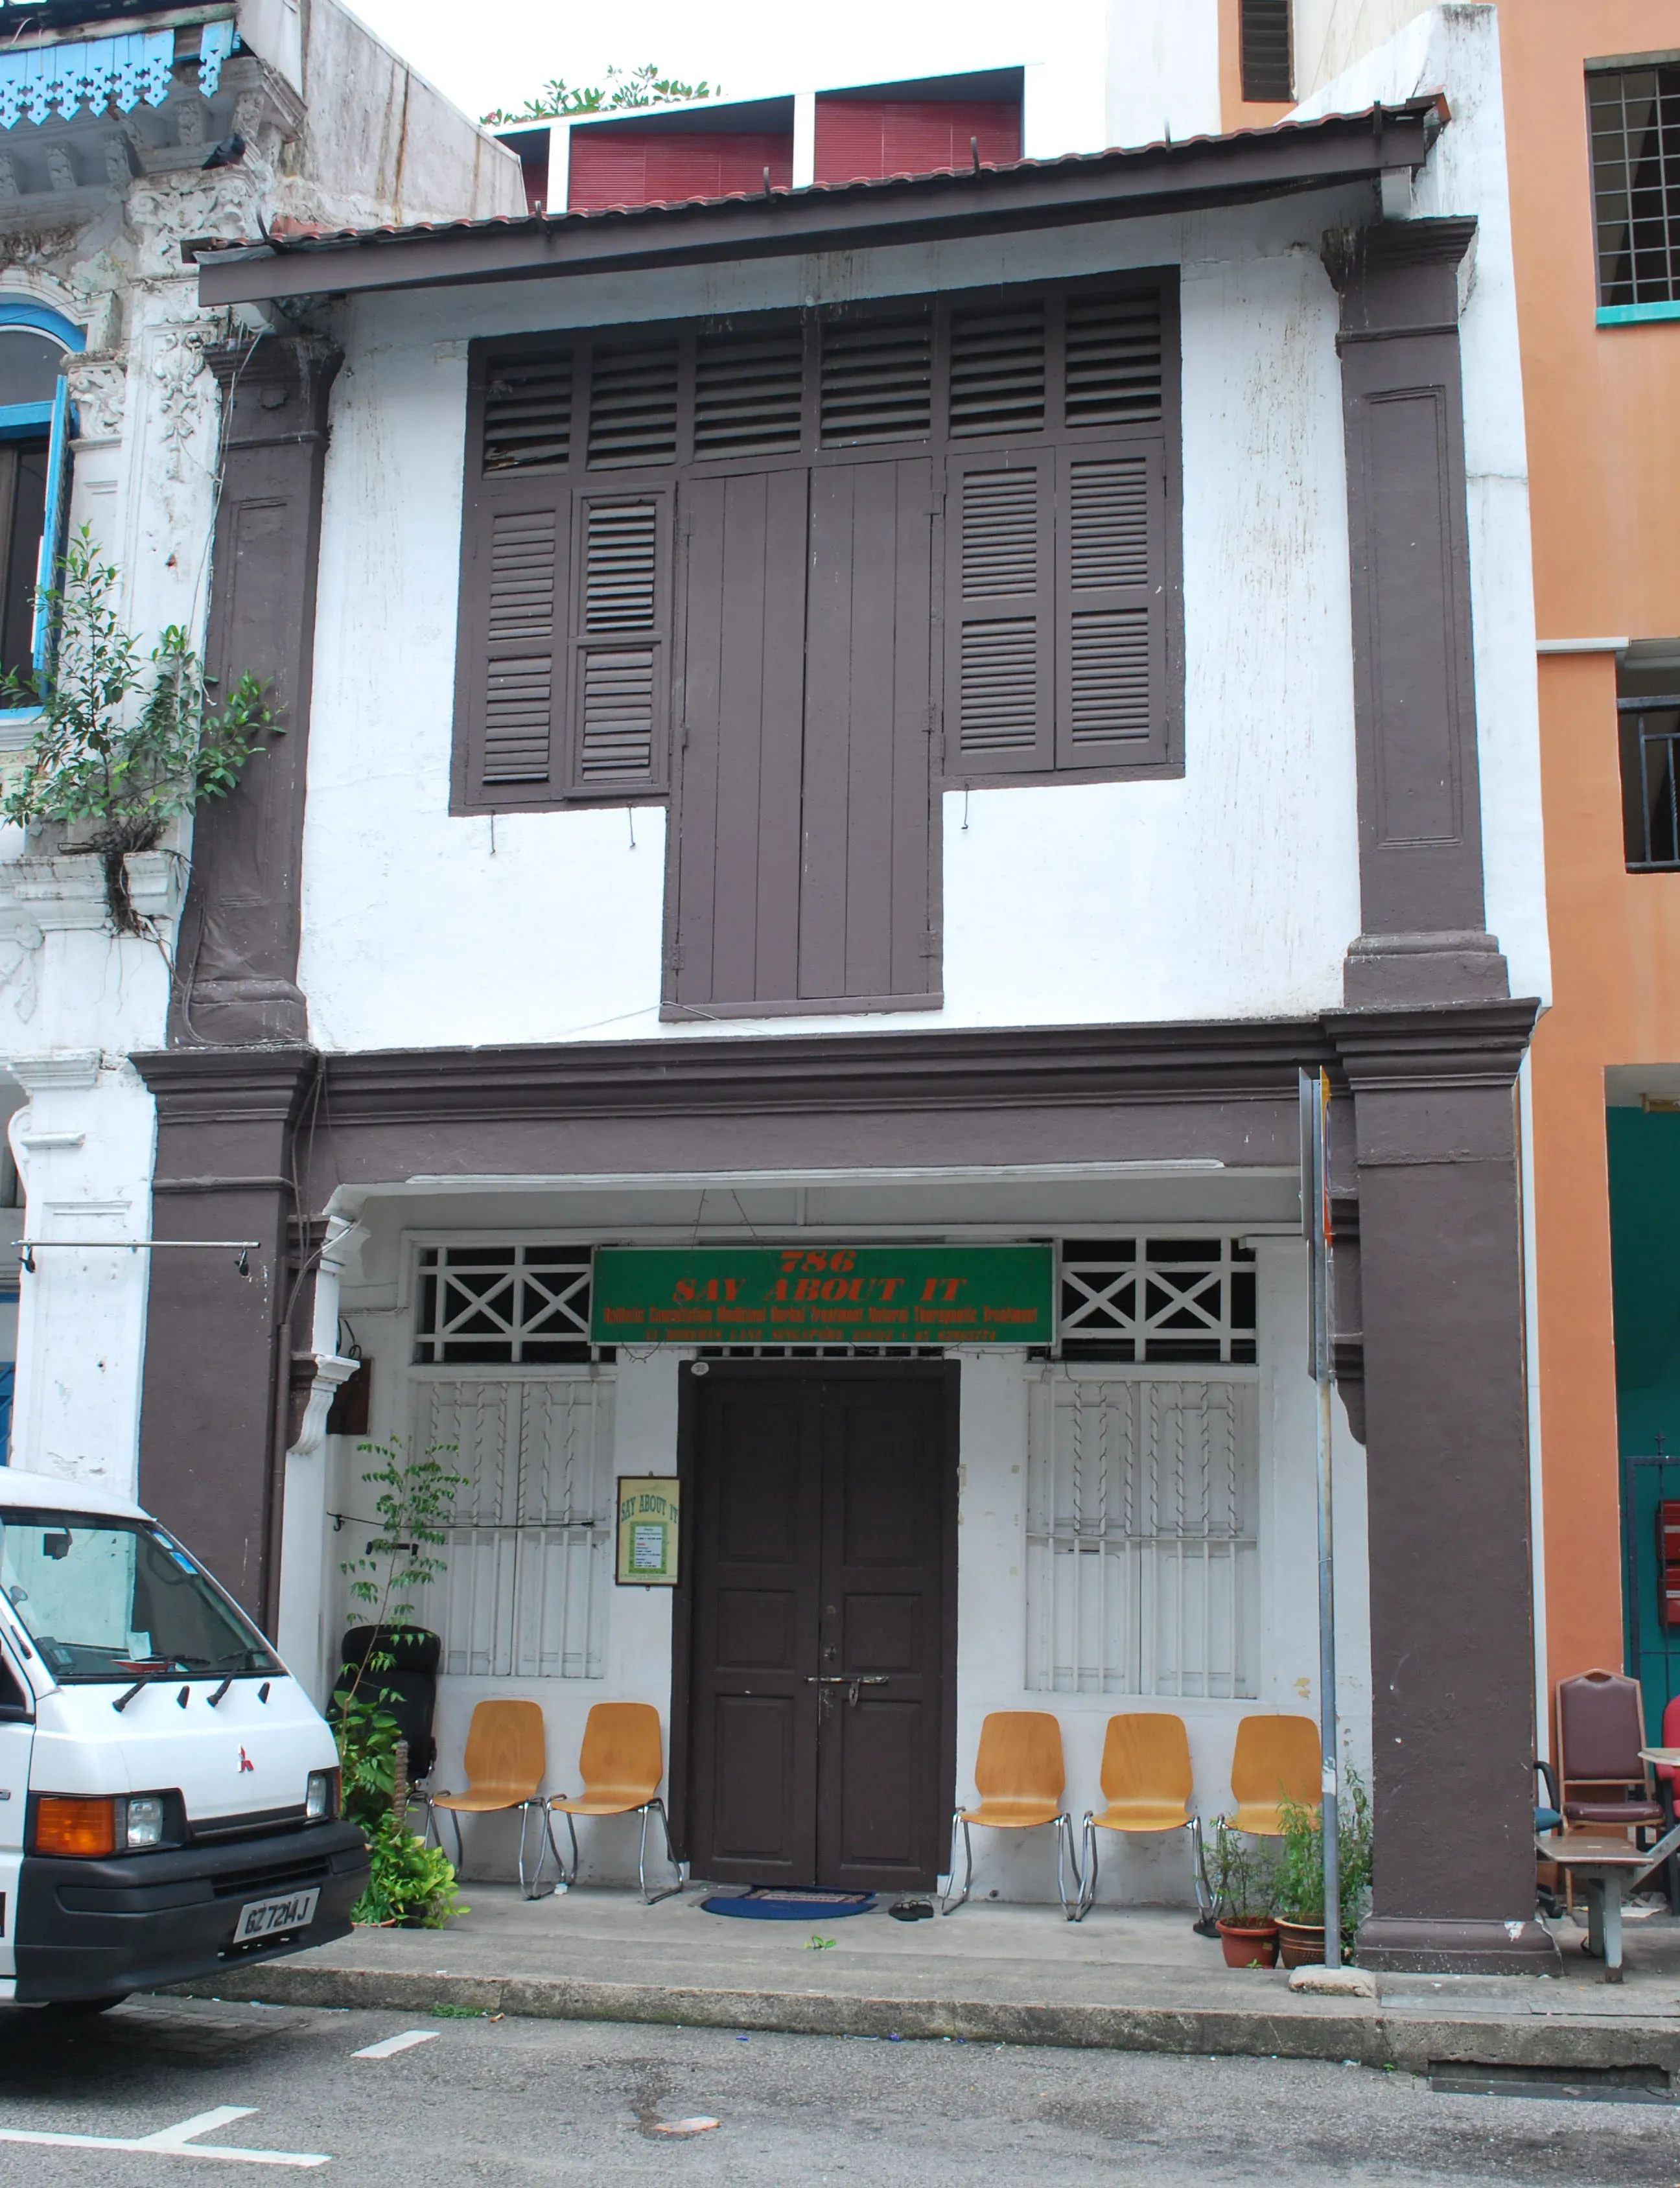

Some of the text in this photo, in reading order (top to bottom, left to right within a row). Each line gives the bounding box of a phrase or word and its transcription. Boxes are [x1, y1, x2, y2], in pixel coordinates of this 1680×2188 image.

[780, 1250, 857, 1272] 786
[671, 1277, 967, 1301] SAY ABOUT IT
[771, 1305, 805, 1323] Herbal
[810, 1305, 863, 1323] Treatment
[983, 1305, 1037, 1323] Treatment
[621, 1496, 636, 1522] SAY
[638, 1493, 667, 1517] ABOUT
